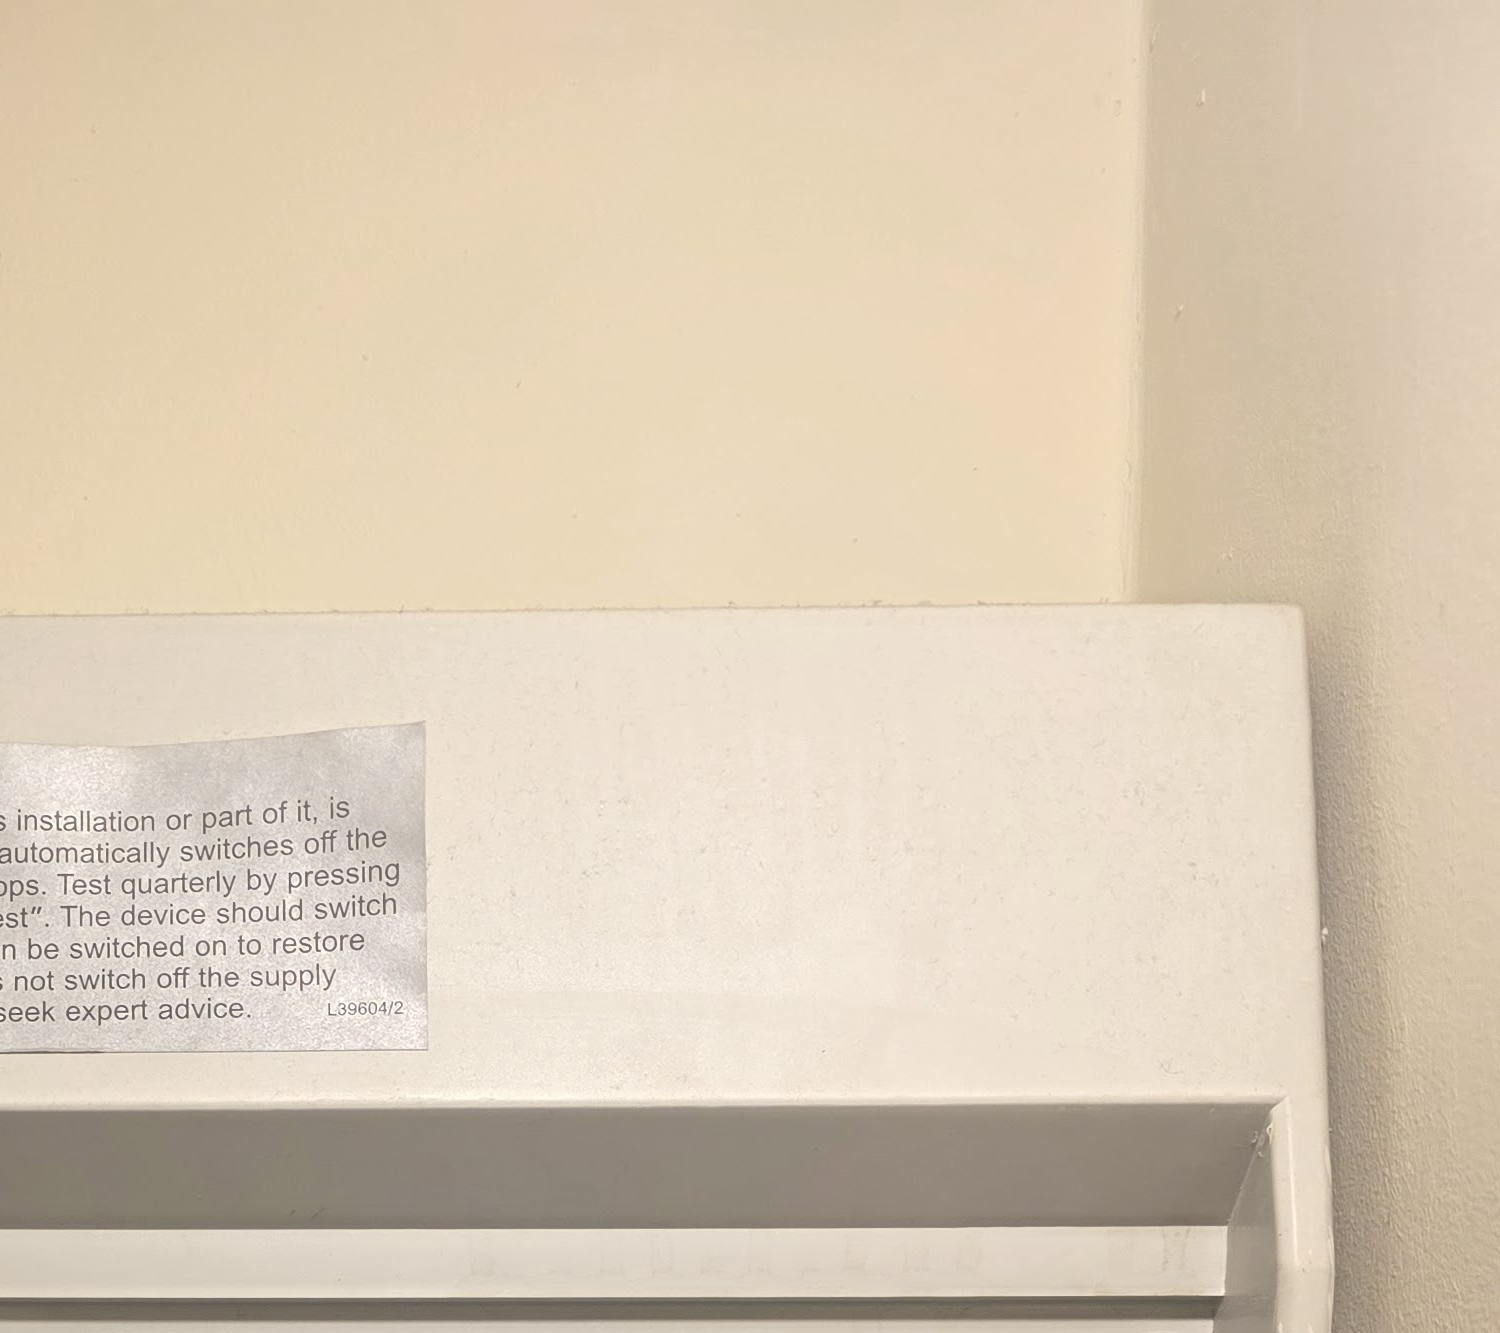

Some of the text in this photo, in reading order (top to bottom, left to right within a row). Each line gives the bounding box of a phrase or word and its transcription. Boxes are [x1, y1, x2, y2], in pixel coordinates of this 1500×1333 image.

[17, 809, 155, 832] installation
[166, 812, 192, 831] or
[202, 804, 253, 834] part
[263, 800, 288, 825] of
[297, 799, 318, 825] it,
[330, 796, 350, 820] is
[180, 836, 294, 862] switches
[304, 830, 338, 855] off
[346, 827, 387, 852] the
[57, 873, 111, 896] Test
[121, 870, 236, 900] quarterly
[247, 868, 277, 896] by
[288, 861, 400, 894] pressing
[328, 1001, 404, 1017] L39604/2
